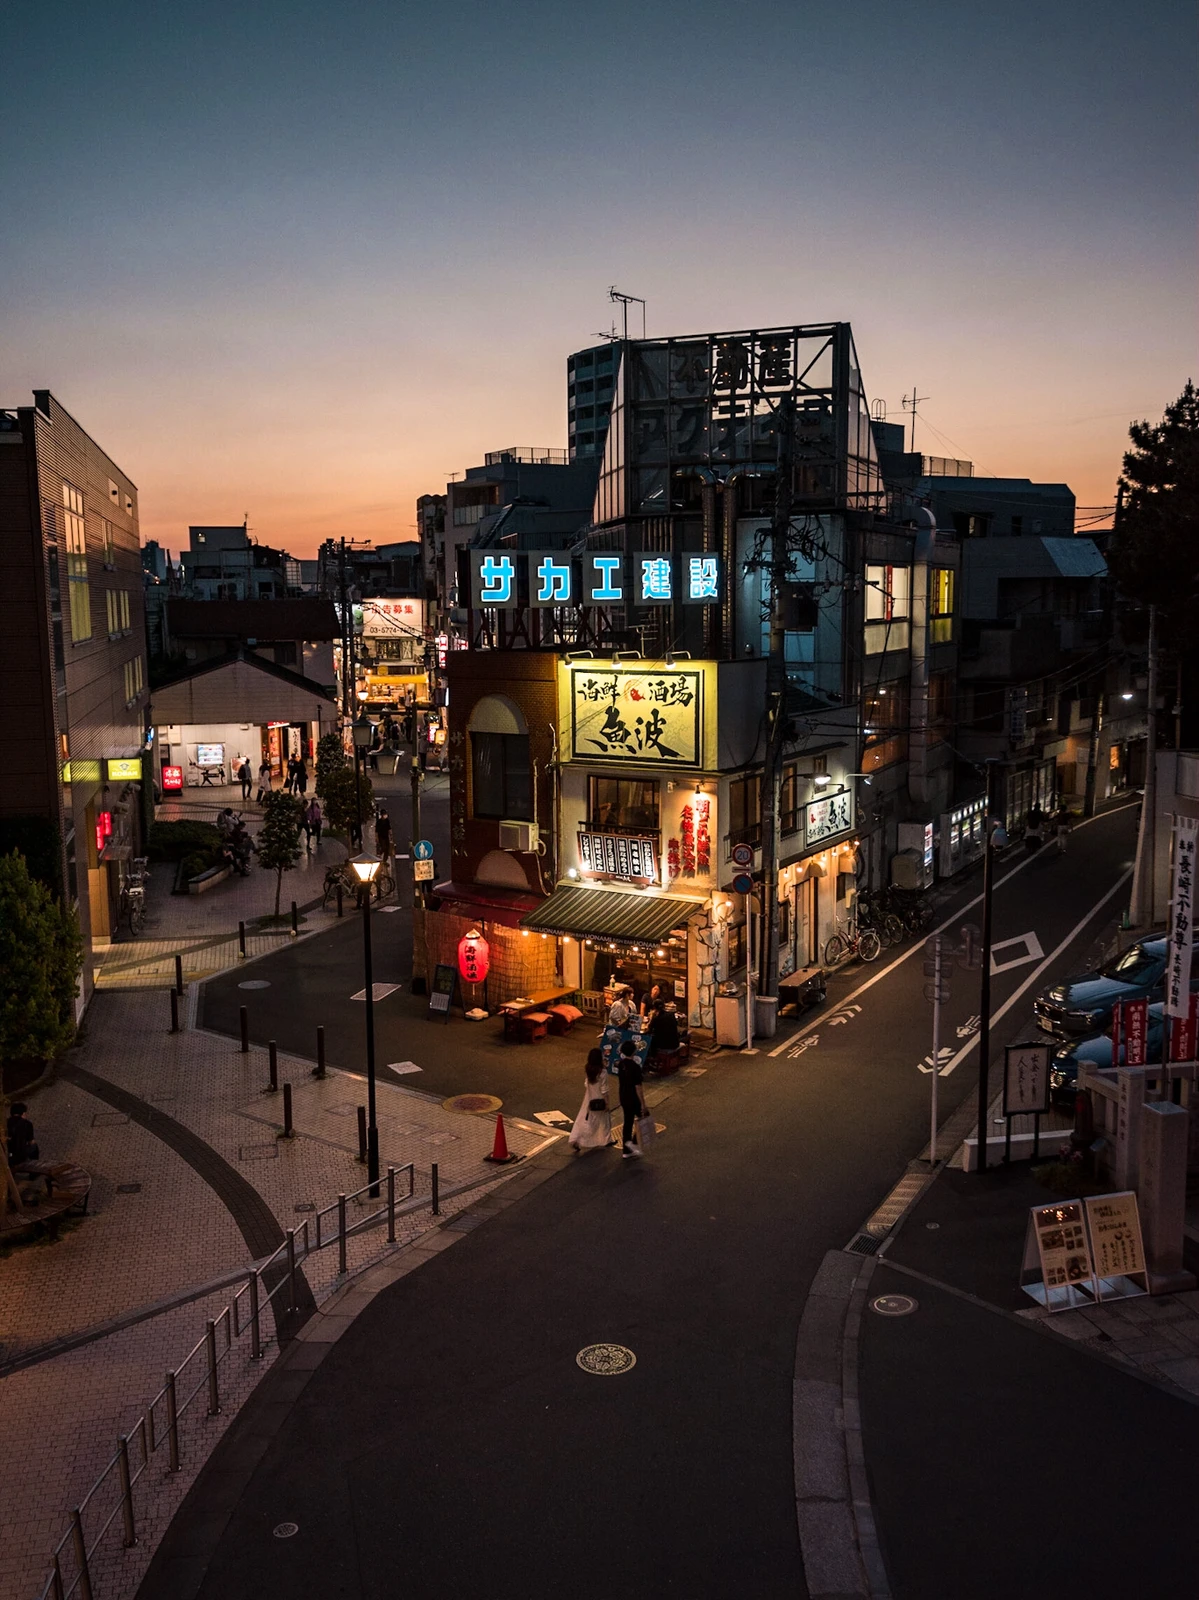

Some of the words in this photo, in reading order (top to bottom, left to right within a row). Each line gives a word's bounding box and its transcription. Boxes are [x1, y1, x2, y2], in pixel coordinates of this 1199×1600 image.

[577, 675, 621, 707] 海鮮
[648, 676, 694, 707] 酒場
[584, 705, 685, 758] 魚波
[737, 850, 749, 860] 20
